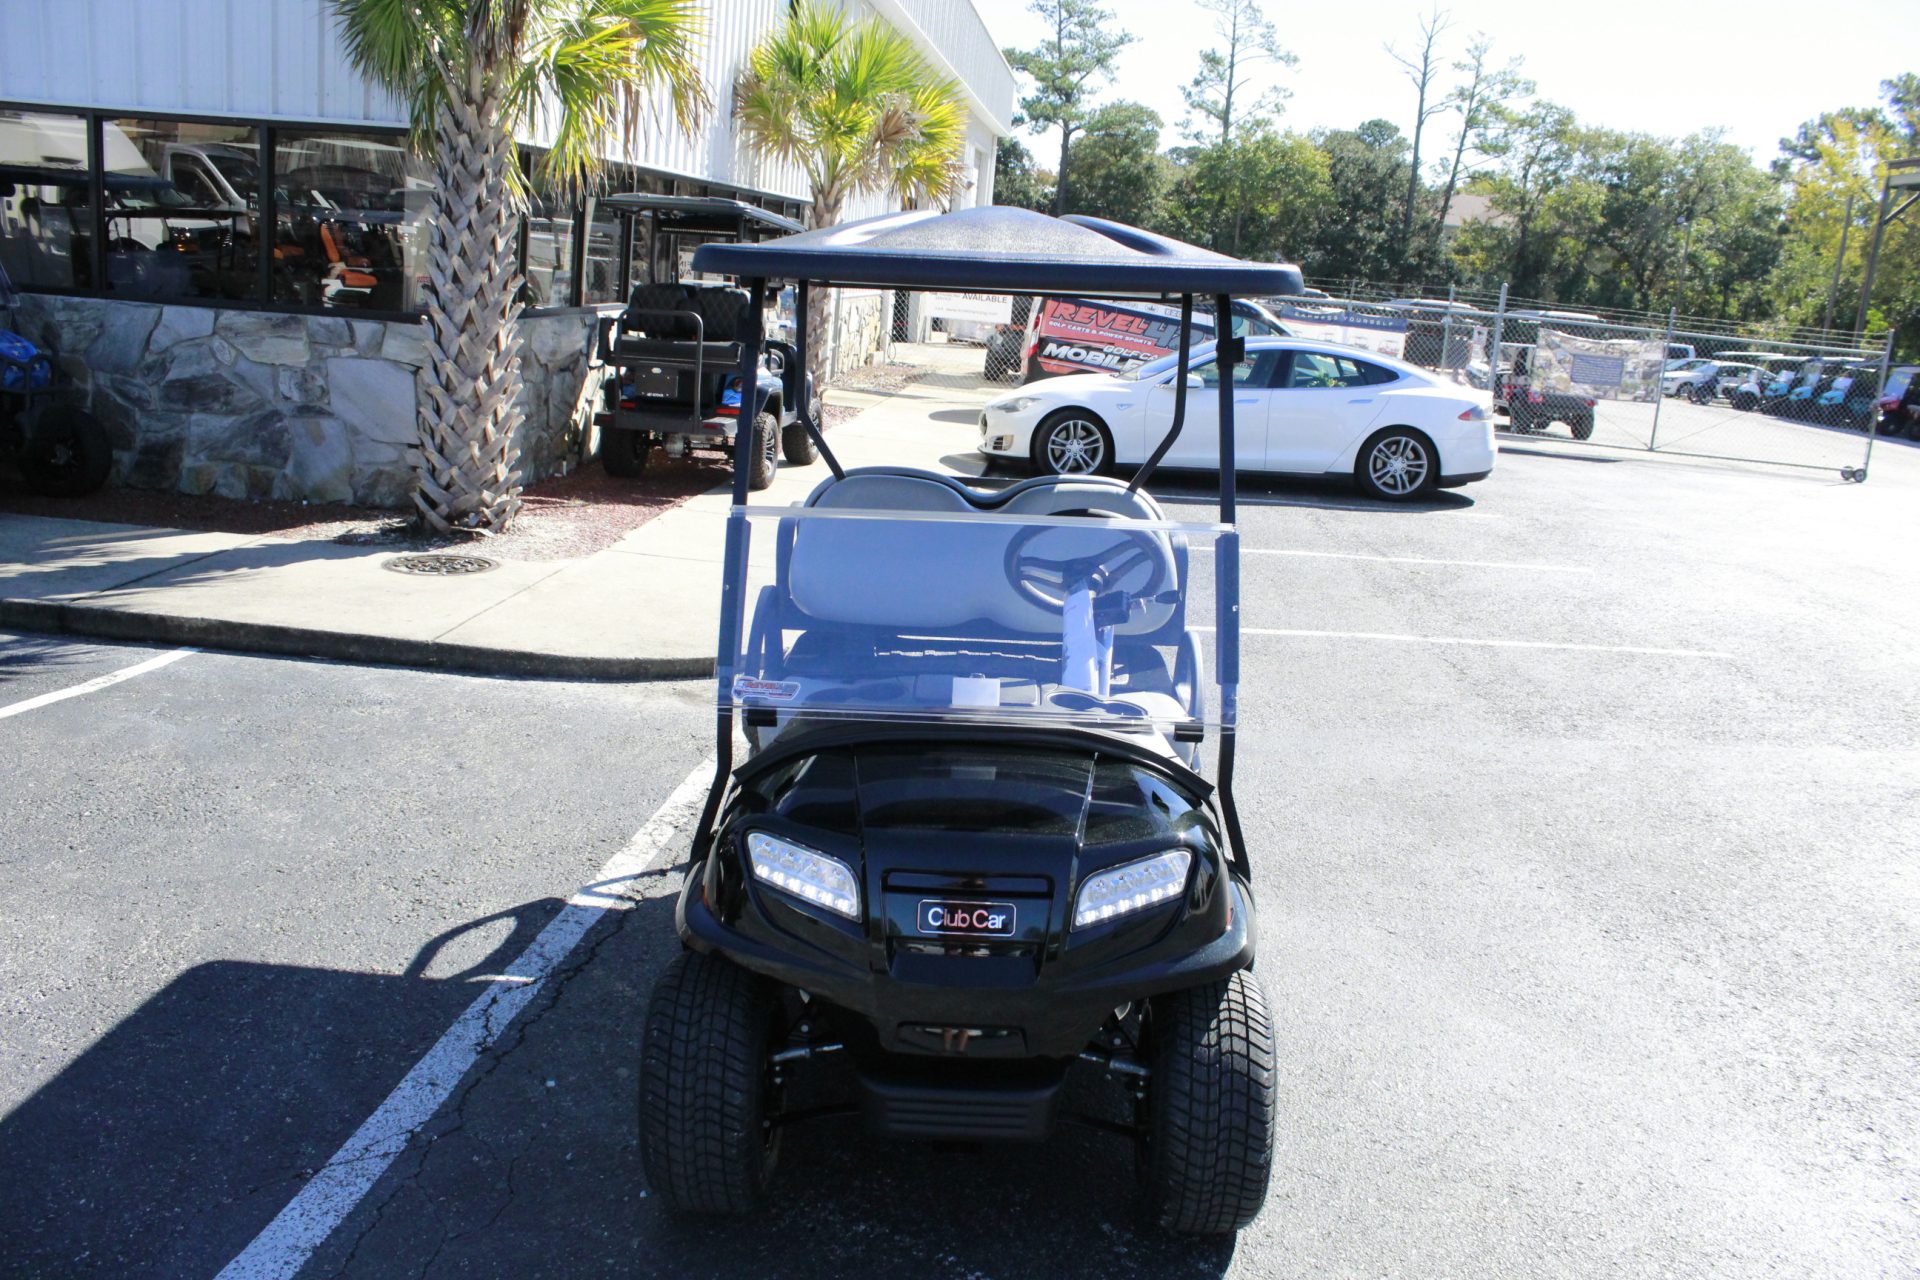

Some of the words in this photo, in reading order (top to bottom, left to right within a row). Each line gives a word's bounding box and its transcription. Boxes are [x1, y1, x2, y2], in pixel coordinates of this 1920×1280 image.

[962, 293, 1008, 304] AVAILABLE
[1343, 316, 1393, 327] YOURSELF
[1048, 320, 1067, 328] GOLF
[1067, 324, 1090, 334] CARTS
[1098, 330, 1124, 340] POWER
[1124, 335, 1153, 346] SPORTS
[1042, 342, 1145, 369] MOBILE
[1102, 345, 1140, 358] GOLF
[927, 906, 970, 929] Club
[972, 909, 1006, 929] Car
